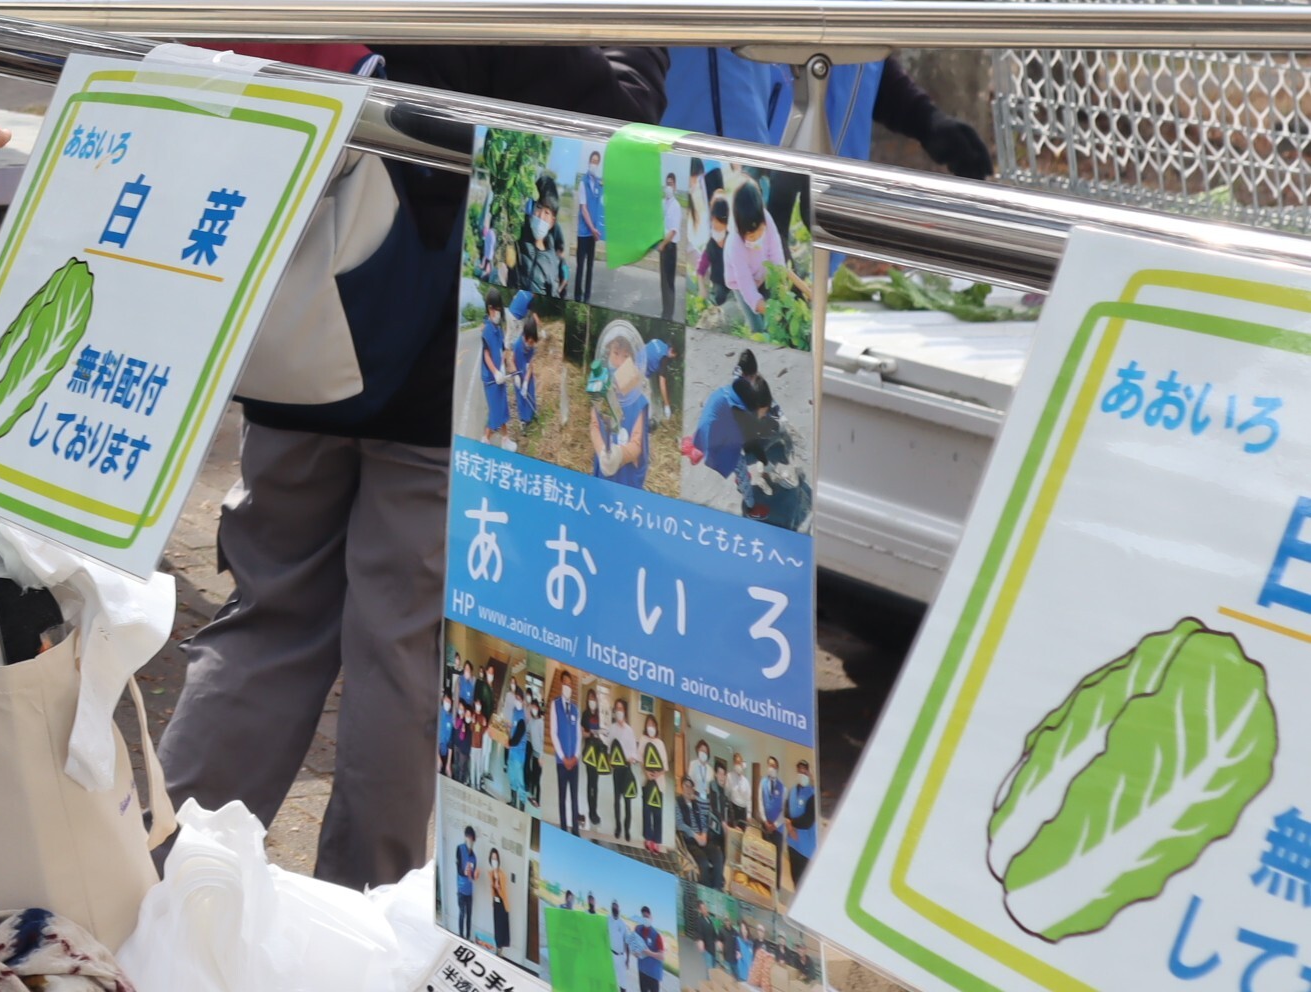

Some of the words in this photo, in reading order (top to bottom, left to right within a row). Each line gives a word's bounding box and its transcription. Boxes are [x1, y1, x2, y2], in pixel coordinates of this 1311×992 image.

[63, 124, 132, 165] あおいろ
[66, 344, 171, 417] 無料配付
[1101, 360, 1284, 455] あおいろ
[28, 402, 152, 481] しております
[454, 449, 591, 516] 特定非営利活動法人
[464, 497, 791, 680] あおいろ
[452, 588, 475, 616] HP
[478, 605, 579, 657] www.aoiro.team/
[586, 635, 675, 682] Instagram
[680, 677, 808, 731] aoiro.tokushima
[442, 964, 480, 992] 半透
[453, 944, 515, 992] 取っ手
[1167, 894, 1311, 992] して
